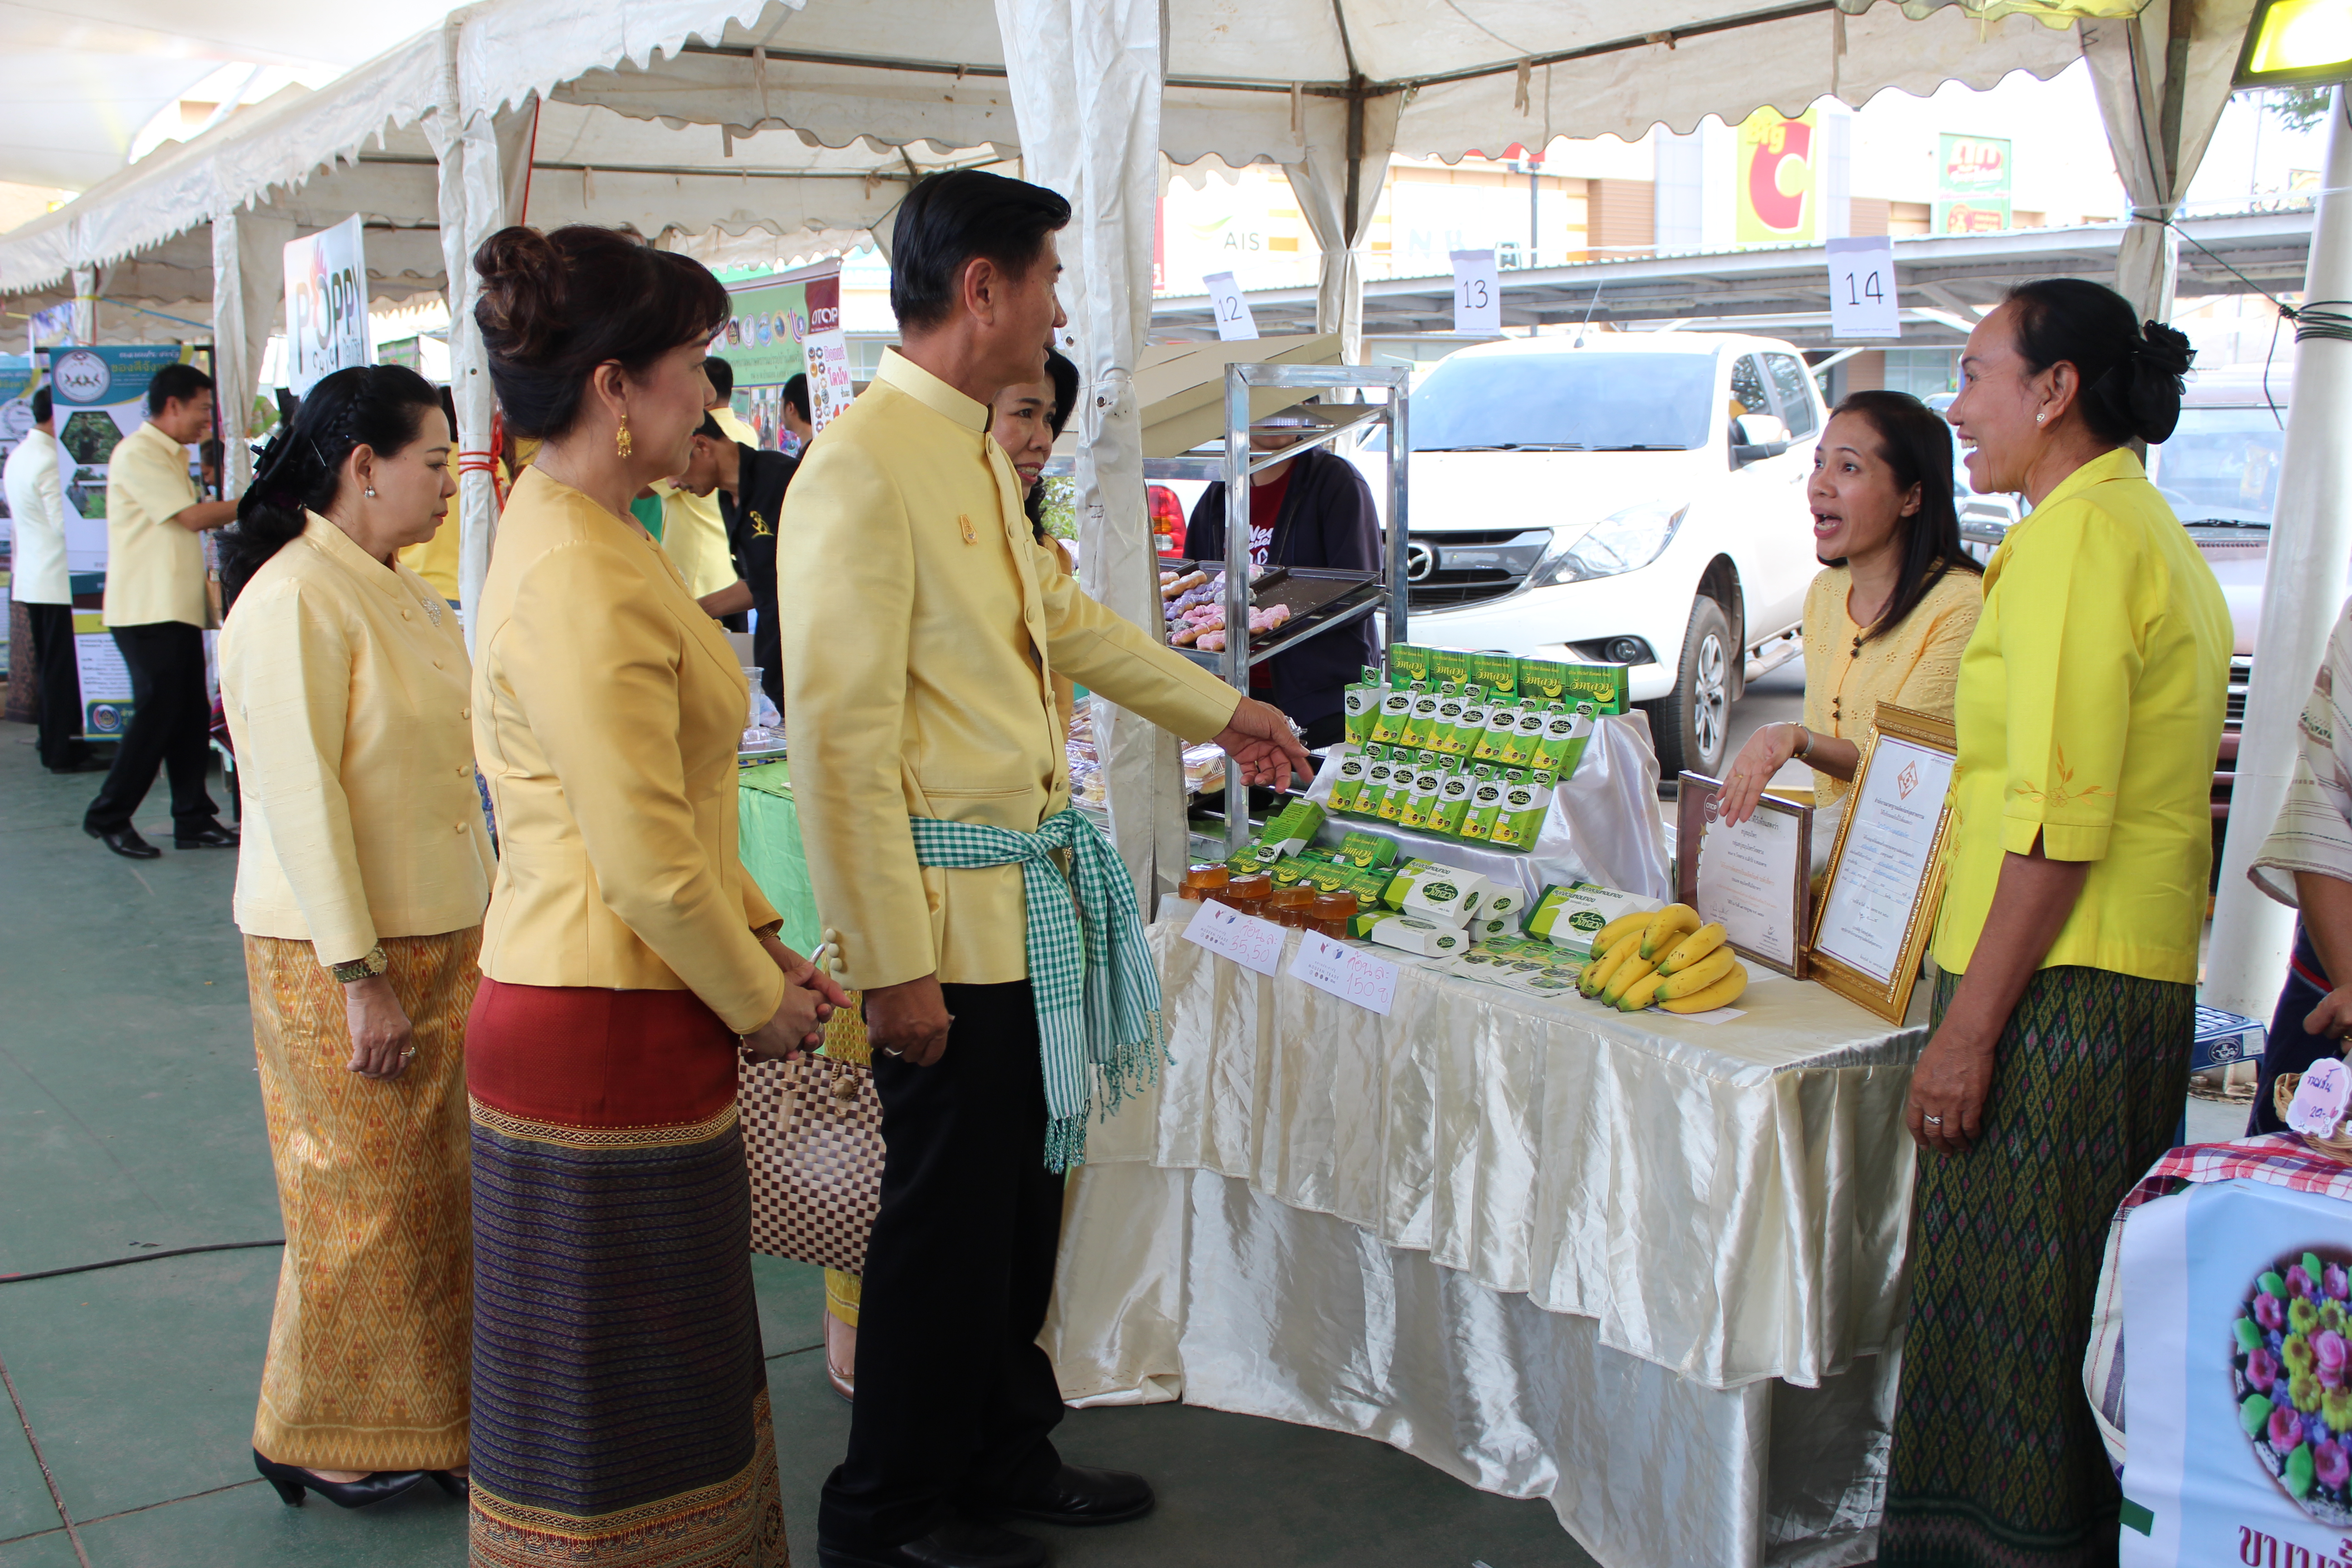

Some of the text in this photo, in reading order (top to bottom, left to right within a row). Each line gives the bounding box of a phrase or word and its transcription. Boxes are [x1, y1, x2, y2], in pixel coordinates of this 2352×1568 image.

[1747, 115, 1812, 231] Big C
[1224, 231, 1259, 251] AIS
[1464, 279, 1488, 309] 13
[1846, 270, 1884, 305] 14
[812, 307, 838, 325] OTOP
[1219, 296, 1242, 322] 12
[823, 343, 845, 362] Donut
[828, 366, 848, 387] โดนัท
[1706, 802, 1717, 810] OTOP
[1552, 890, 1596, 903] สบู่กล้วยหอมทอง
[1579, 886, 1623, 899] สบู่กล้วยหอมทอง
[1570, 913, 1603, 930] วังหลวง
[1200, 927, 1215, 936] MODERN
[1229, 936, 1269, 962] 35,50
[1308, 964, 1339, 980] MODERN TRADE
[1347, 973, 1374, 997] 150
